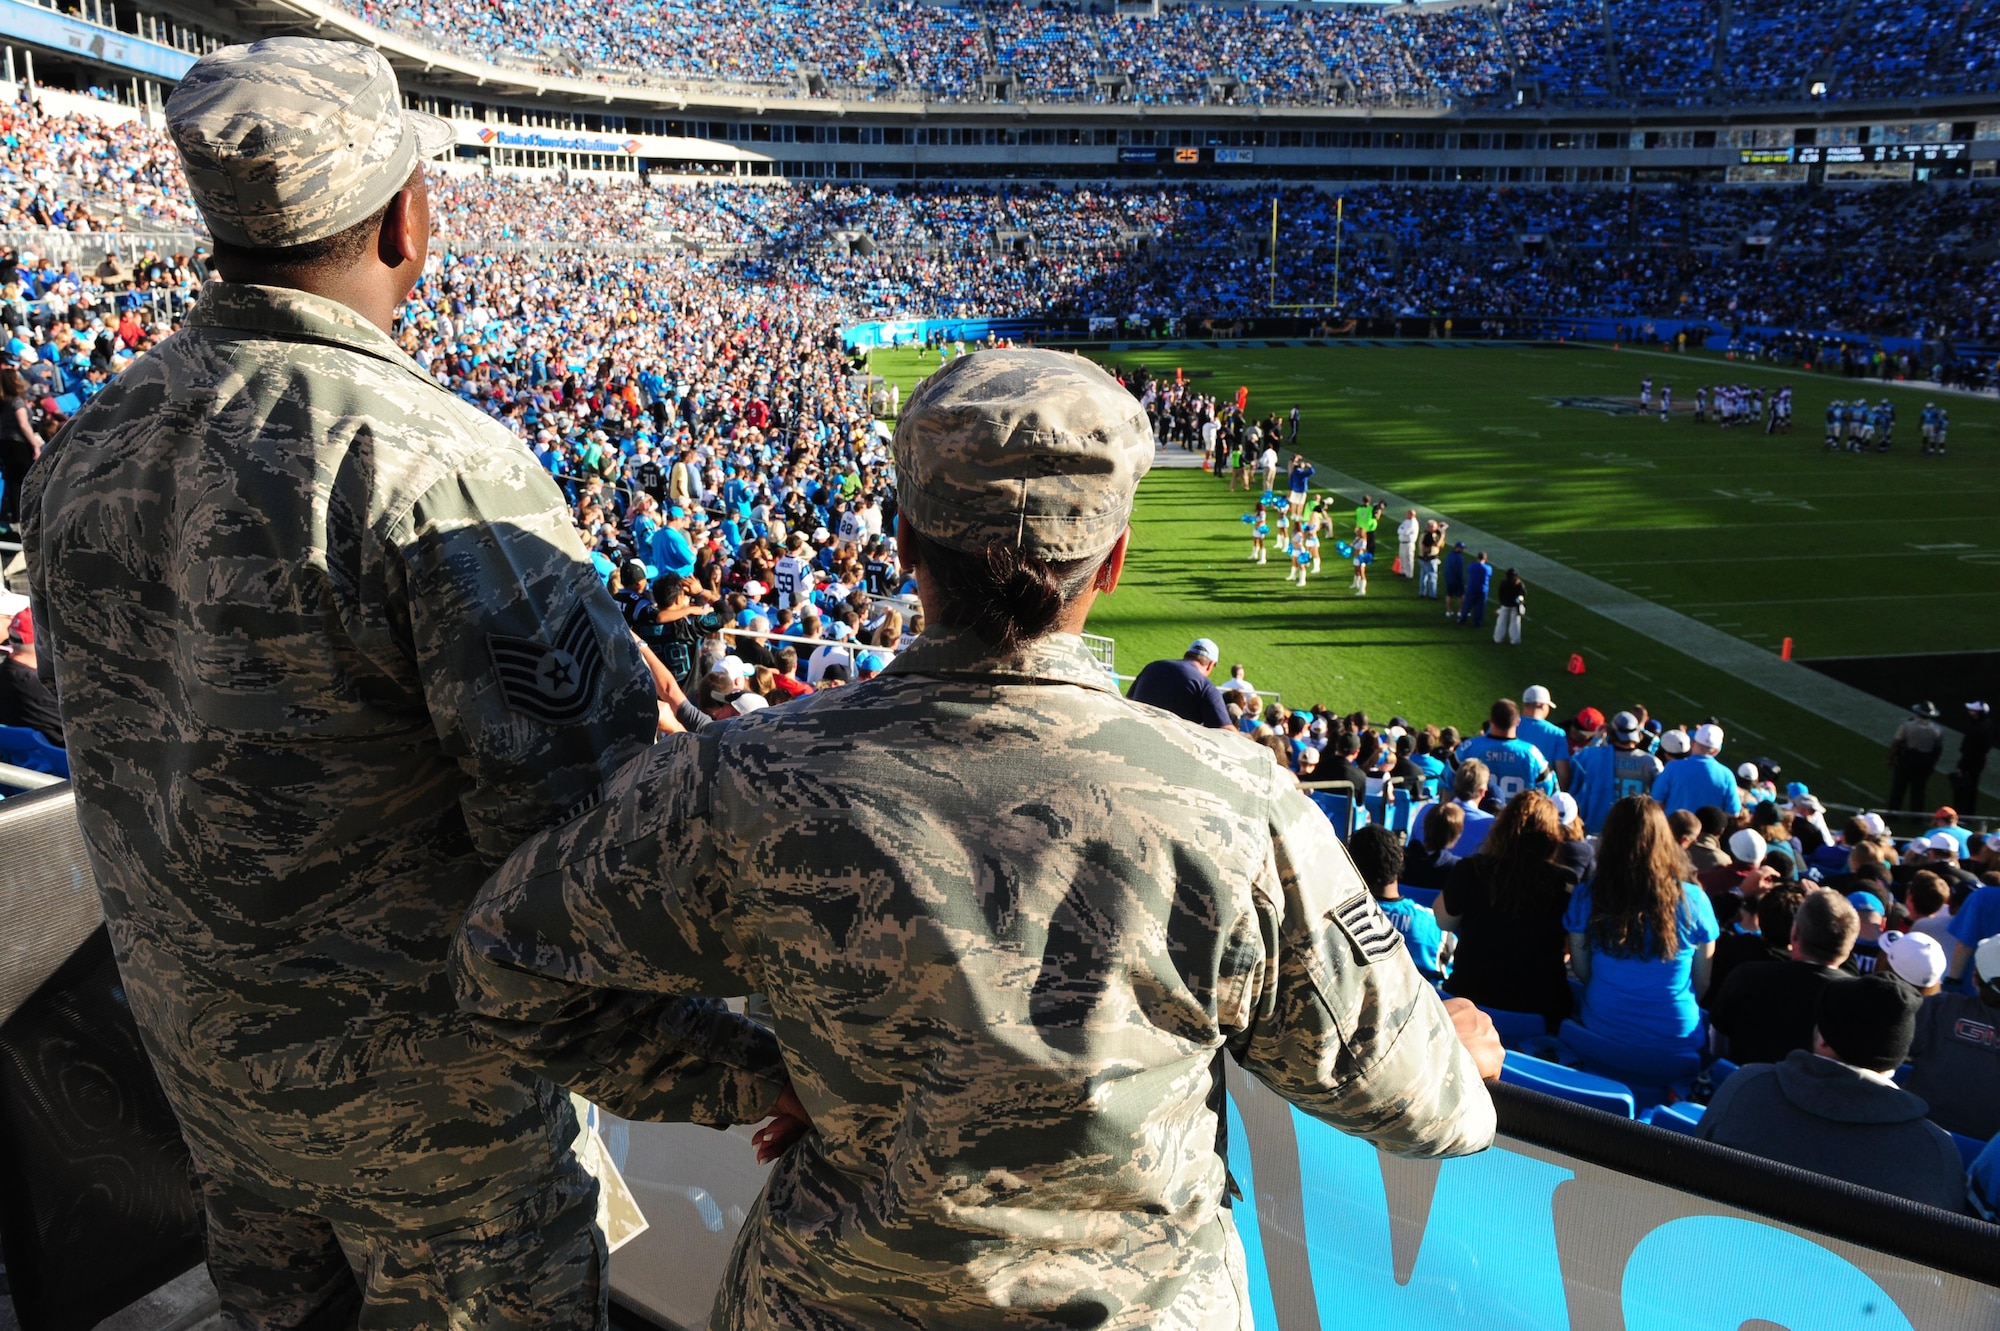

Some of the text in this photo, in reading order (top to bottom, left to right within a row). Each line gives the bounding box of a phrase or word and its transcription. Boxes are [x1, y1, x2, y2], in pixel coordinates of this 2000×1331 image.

[497, 131, 524, 145] Bank
[536, 134, 577, 149] America
[577, 138, 619, 151] Stadium
[1175, 149, 1198, 163] 25
[1238, 152, 1251, 160] NC
[643, 474, 657, 488] 30
[729, 486, 735, 503] 1
[778, 573, 795, 594] 59
[871, 575, 878, 592] 1
[1486, 751, 1515, 763] SMITH
